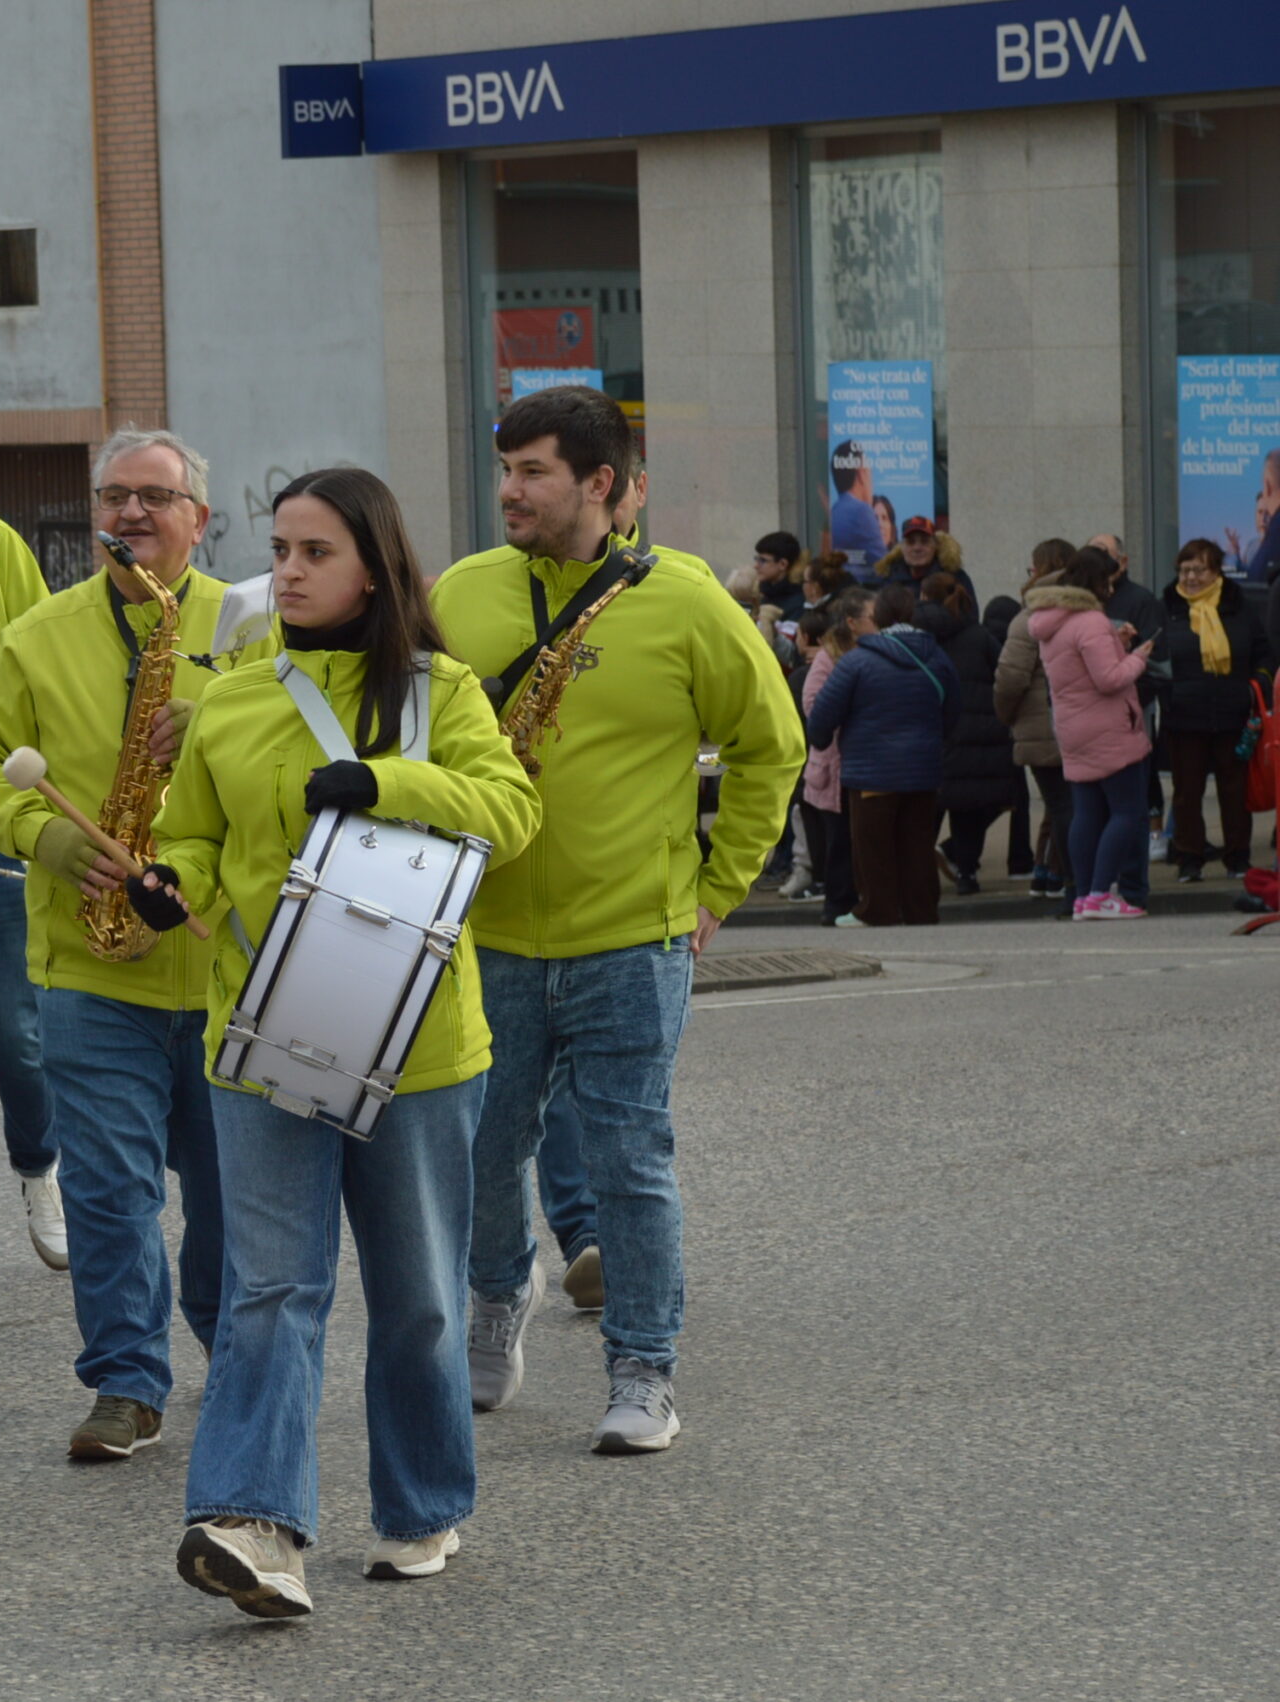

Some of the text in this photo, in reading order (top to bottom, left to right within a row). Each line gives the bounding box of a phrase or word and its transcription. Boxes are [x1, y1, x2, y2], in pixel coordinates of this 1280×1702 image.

[996, 5, 1147, 82] BBVA
[446, 60, 565, 127] BBVA
[293, 97, 355, 123] BBVA
[867, 373, 880, 383] se
[882, 369, 911, 383] trata
[912, 367, 928, 382] de
[1237, 358, 1278, 379] mejor
[832, 385, 909, 404] competir con
[1181, 382, 1224, 400] grupo
[1226, 379, 1244, 396] de
[846, 404, 877, 417] otros
[833, 419, 892, 434] se trata de
[1227, 418, 1250, 436] del
[850, 437, 928, 455] competir con
[1182, 437, 1260, 455] de la banca
[833, 454, 862, 469] todo
[875, 457, 898, 473] que
